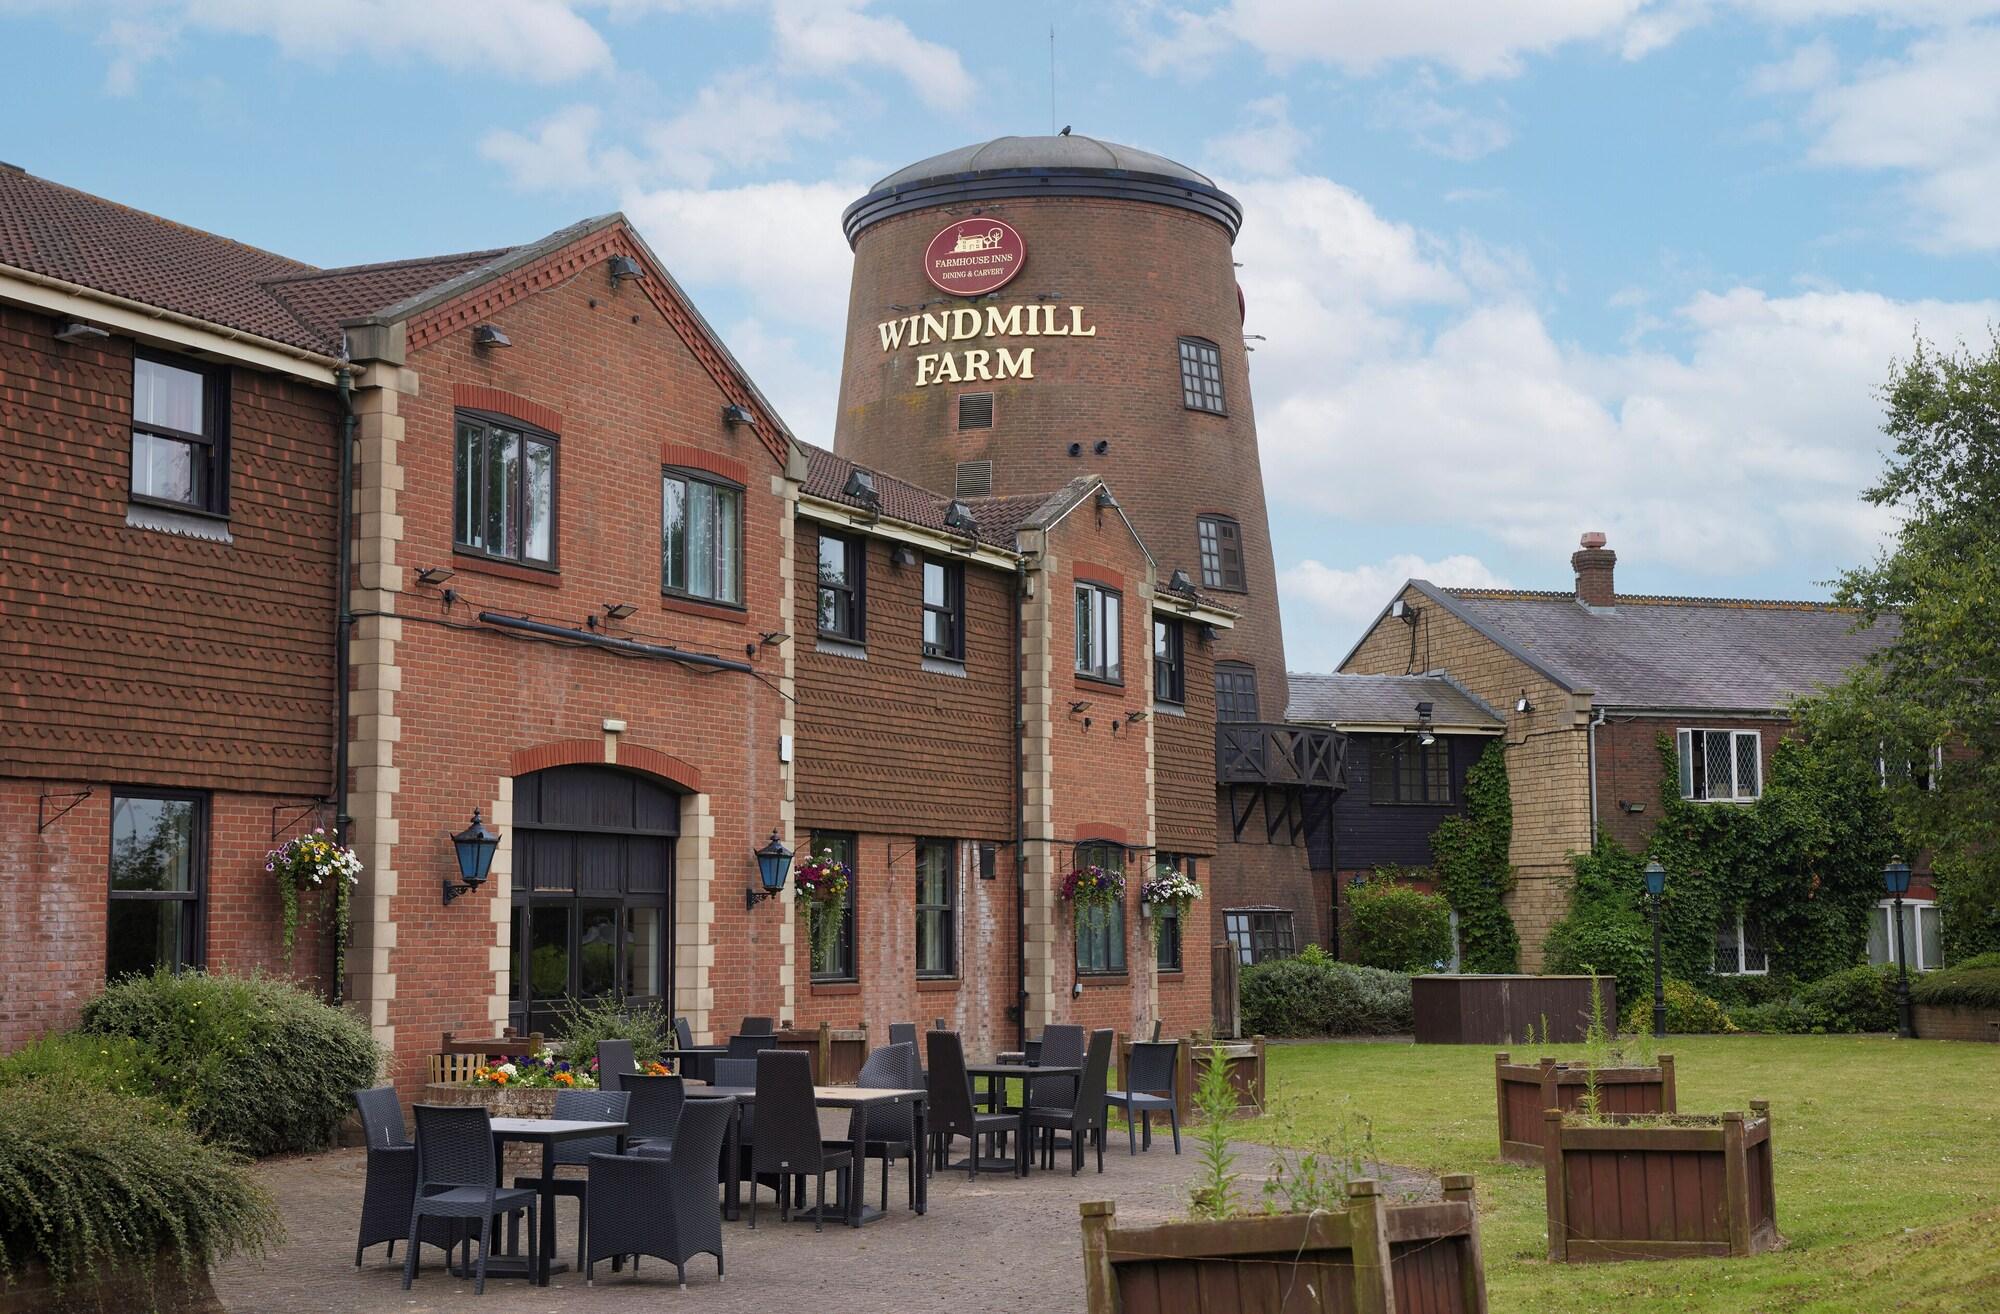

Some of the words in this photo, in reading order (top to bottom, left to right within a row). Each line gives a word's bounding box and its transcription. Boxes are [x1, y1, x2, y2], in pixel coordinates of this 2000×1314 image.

[935, 256, 990, 268] FARMHOUSE
[991, 254, 1013, 263] INNS
[942, 271, 966, 280] DINING
[973, 268, 1004, 277] CARVERY
[878, 305, 1096, 352] WINDMILL
[915, 347, 1035, 387] FARM
